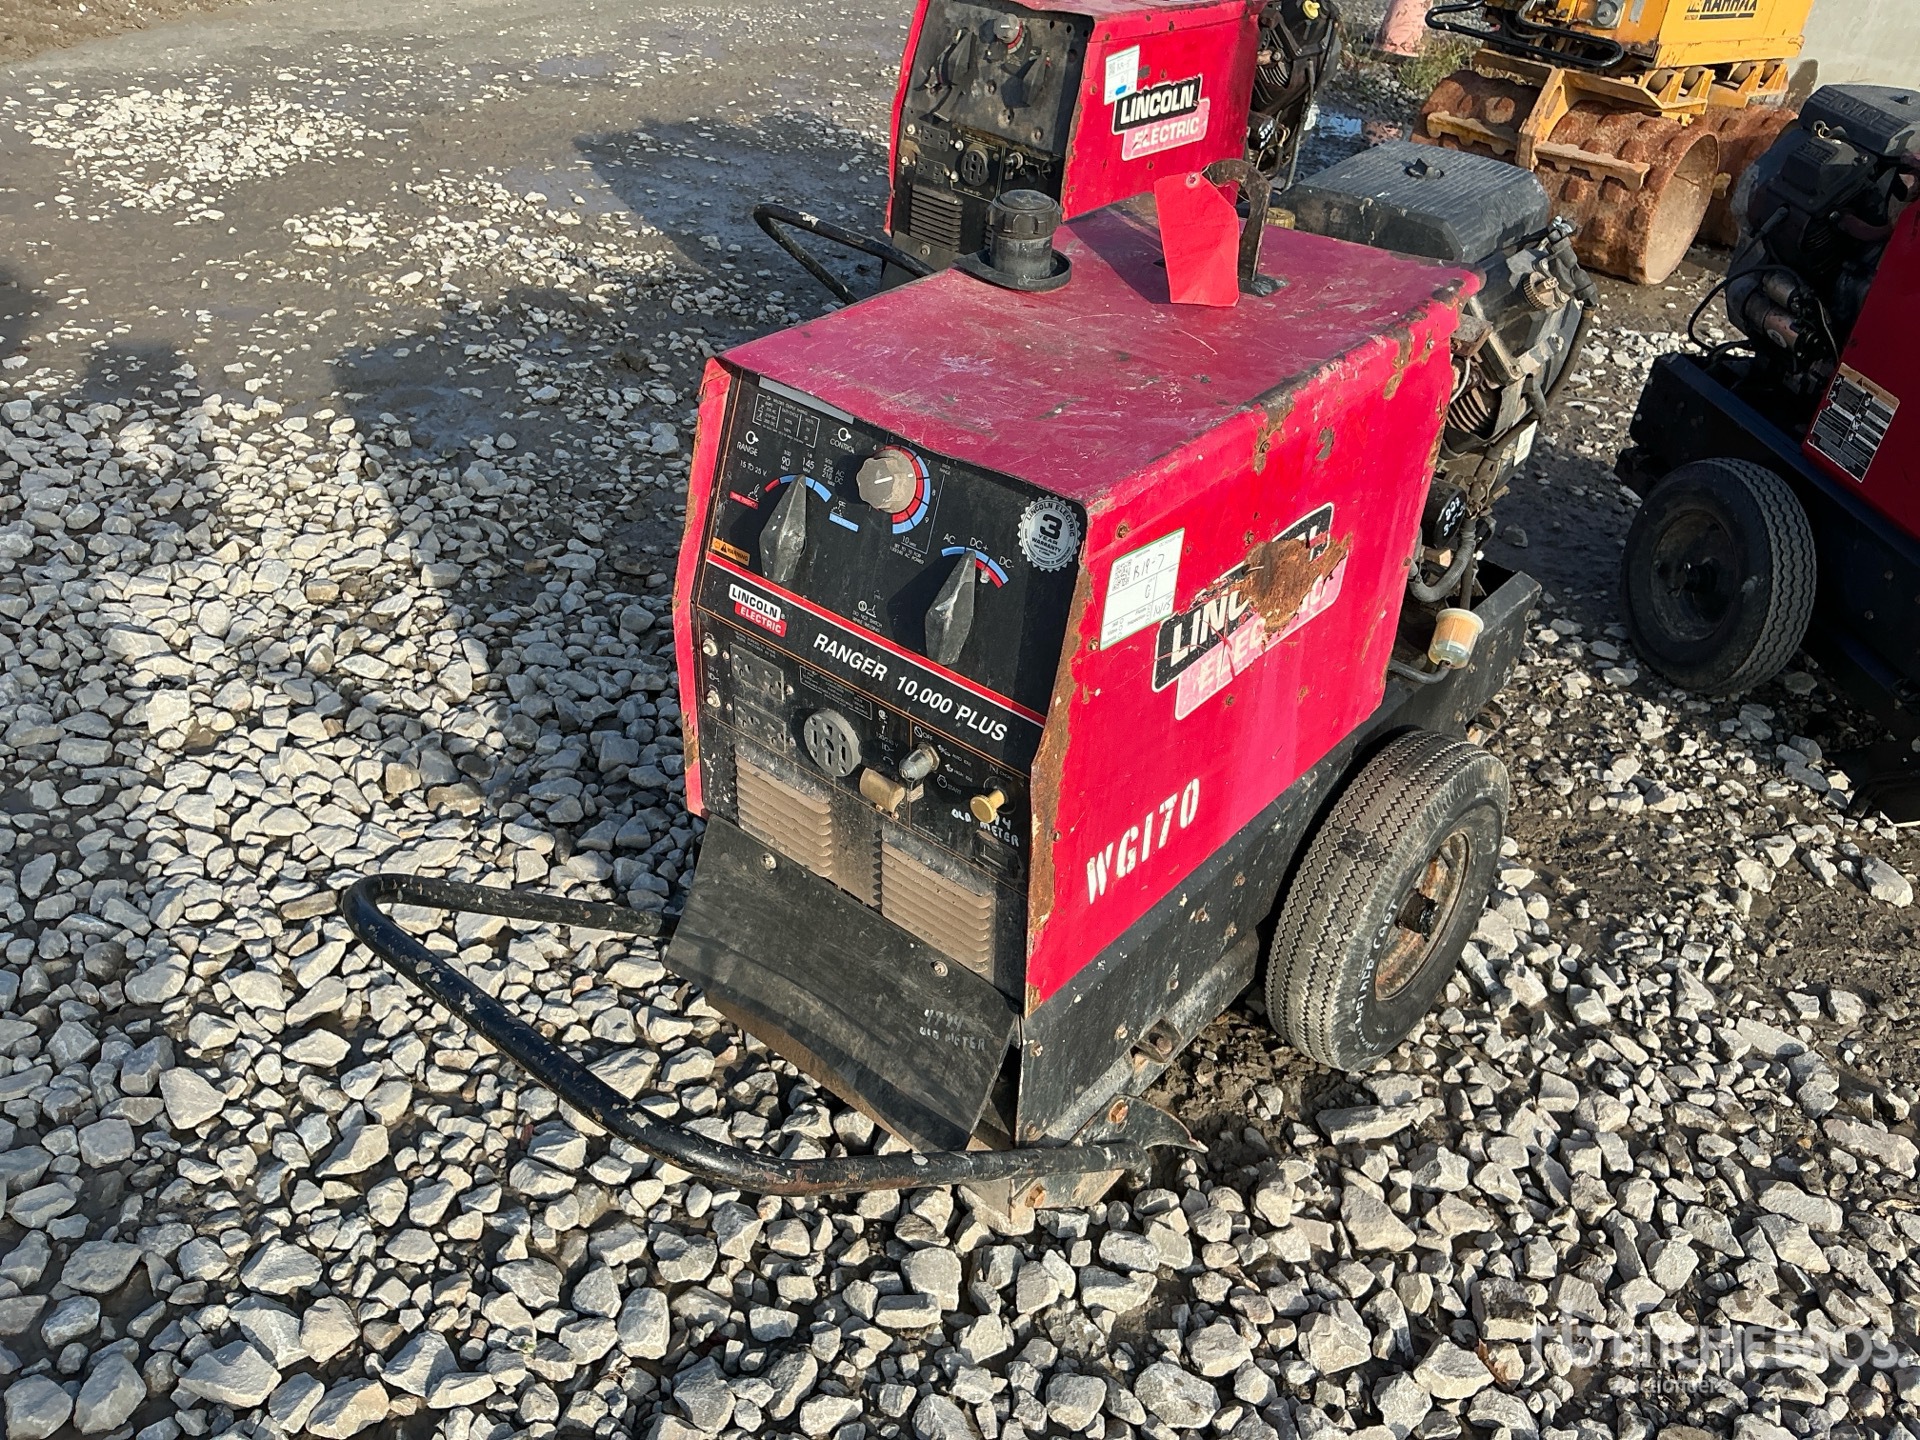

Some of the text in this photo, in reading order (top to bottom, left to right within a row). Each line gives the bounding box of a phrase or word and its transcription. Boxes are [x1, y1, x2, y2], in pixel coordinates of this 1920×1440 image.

[1120, 84, 1195, 125] LINCOLN
[1131, 117, 1200, 150] ELECTRIC
[736, 441, 758, 457] RANGE
[740, 460, 747, 469] 15
[748, 462, 755, 471] TO
[755, 466, 762, 475] 25
[781, 456, 791, 467] 90
[802, 457, 815, 469] 145
[822, 471, 844, 485] 210 DC
[823, 464, 845, 479] 225 AC
[924, 516, 930, 524] 9
[1025, 502, 1076, 537] LINCOLN ELECTRIC
[1039, 513, 1063, 540] 3
[902, 535, 910, 544] 10
[943, 533, 956, 545] AC
[969, 536, 989, 552] DC+
[1031, 537, 1062, 553] WARRANTY
[1038, 533, 1059, 546] YEAR
[726, 545, 749, 563] WARNING
[999, 555, 1015, 569] DC-
[731, 587, 778, 619] LINCOLN
[740, 607, 782, 634] ELECTRIC
[813, 632, 888, 682] RANGER
[896, 675, 953, 714] 10,000
[954, 704, 1008, 742] PLUS
[922, 732, 934, 742] OFF
[952, 753, 963, 762] AUTO
[947, 784, 962, 795] START
[951, 808, 972, 823] OLD
[1086, 778, 1200, 905] WG170
[1354, 958, 1375, 1025] WELDER
[1372, 898, 1399, 950] CART
